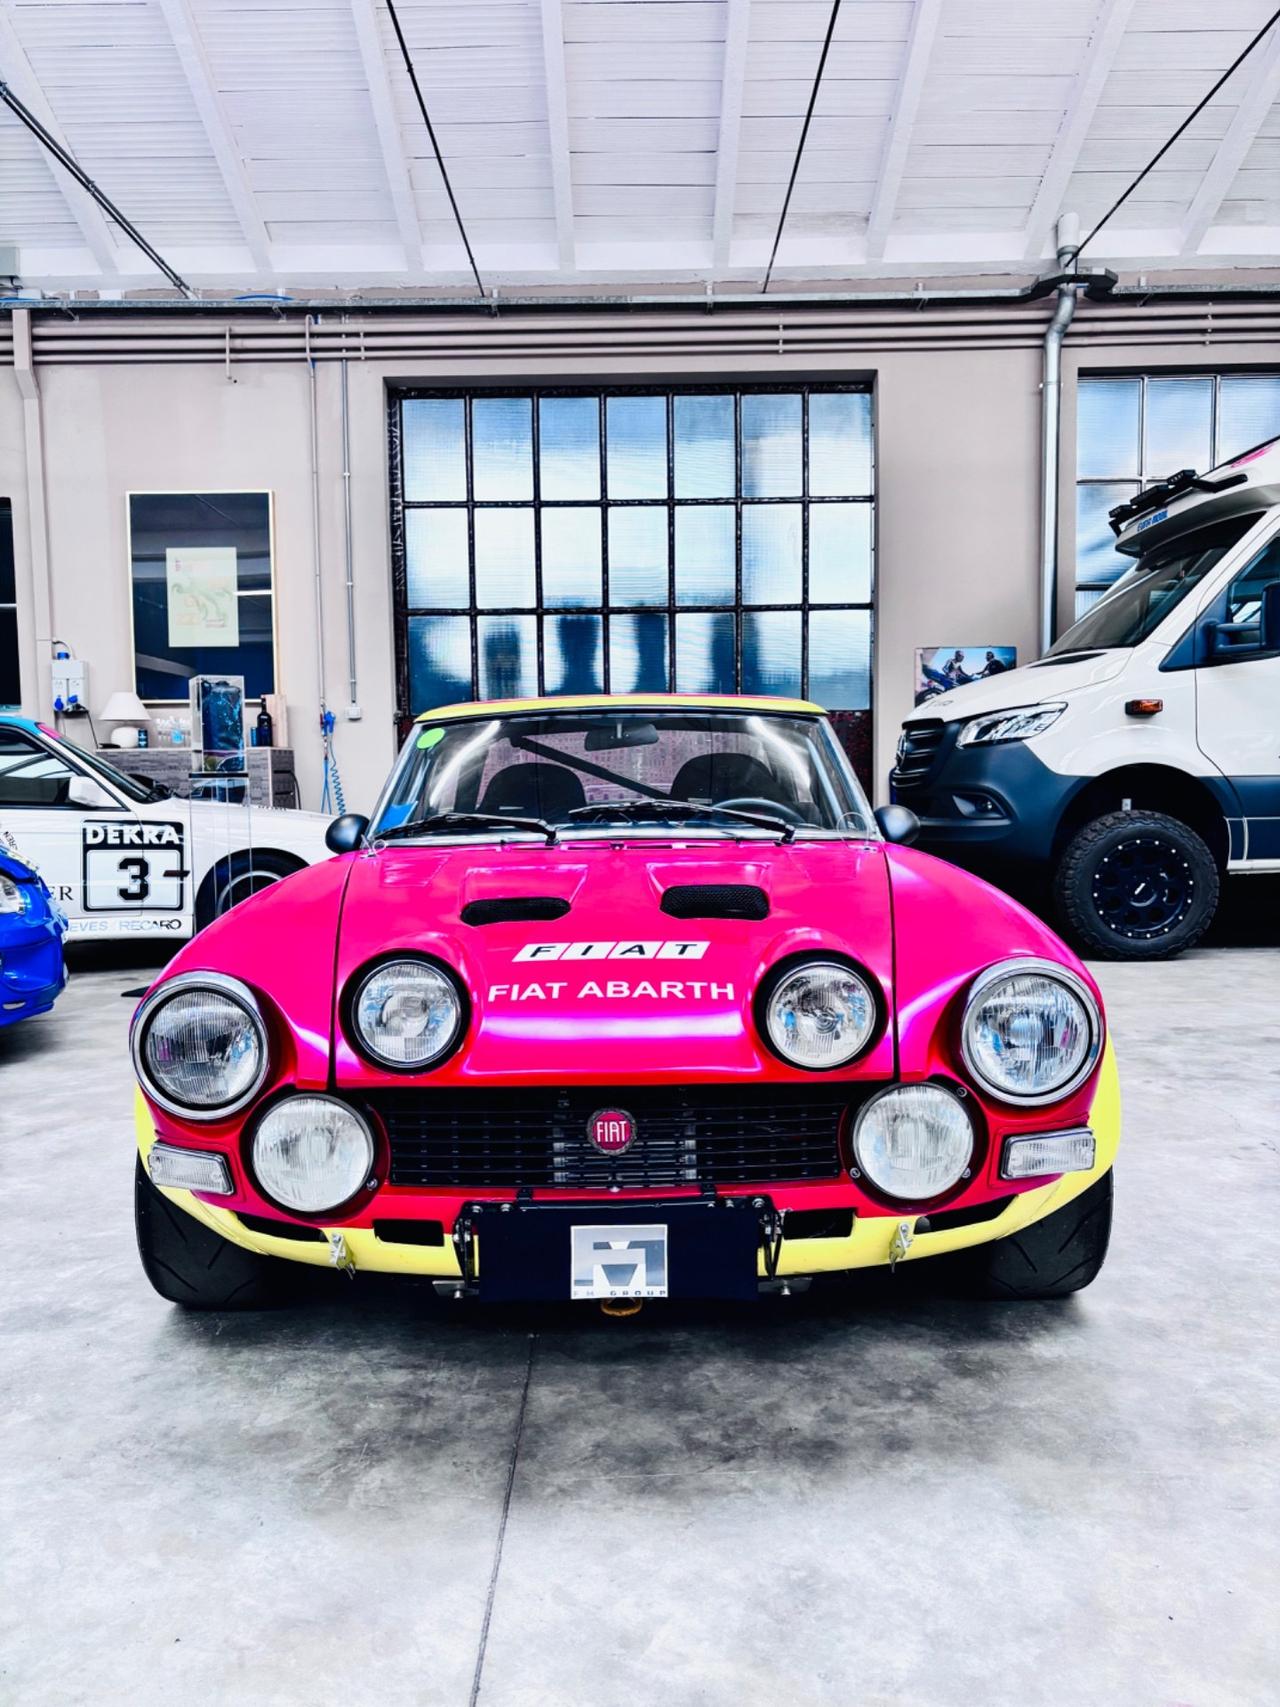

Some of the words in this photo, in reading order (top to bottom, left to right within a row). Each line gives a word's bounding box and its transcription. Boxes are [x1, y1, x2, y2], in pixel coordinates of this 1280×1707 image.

[86, 823, 180, 845] DEKRA
[118, 857, 150, 901] 3
[119, 918, 182, 931] RECARO
[528, 943, 699, 958] FIAT
[487, 982, 568, 1002] FIAT
[577, 980, 735, 1001] ABARTH
[596, 1120, 627, 1143] FIAT
